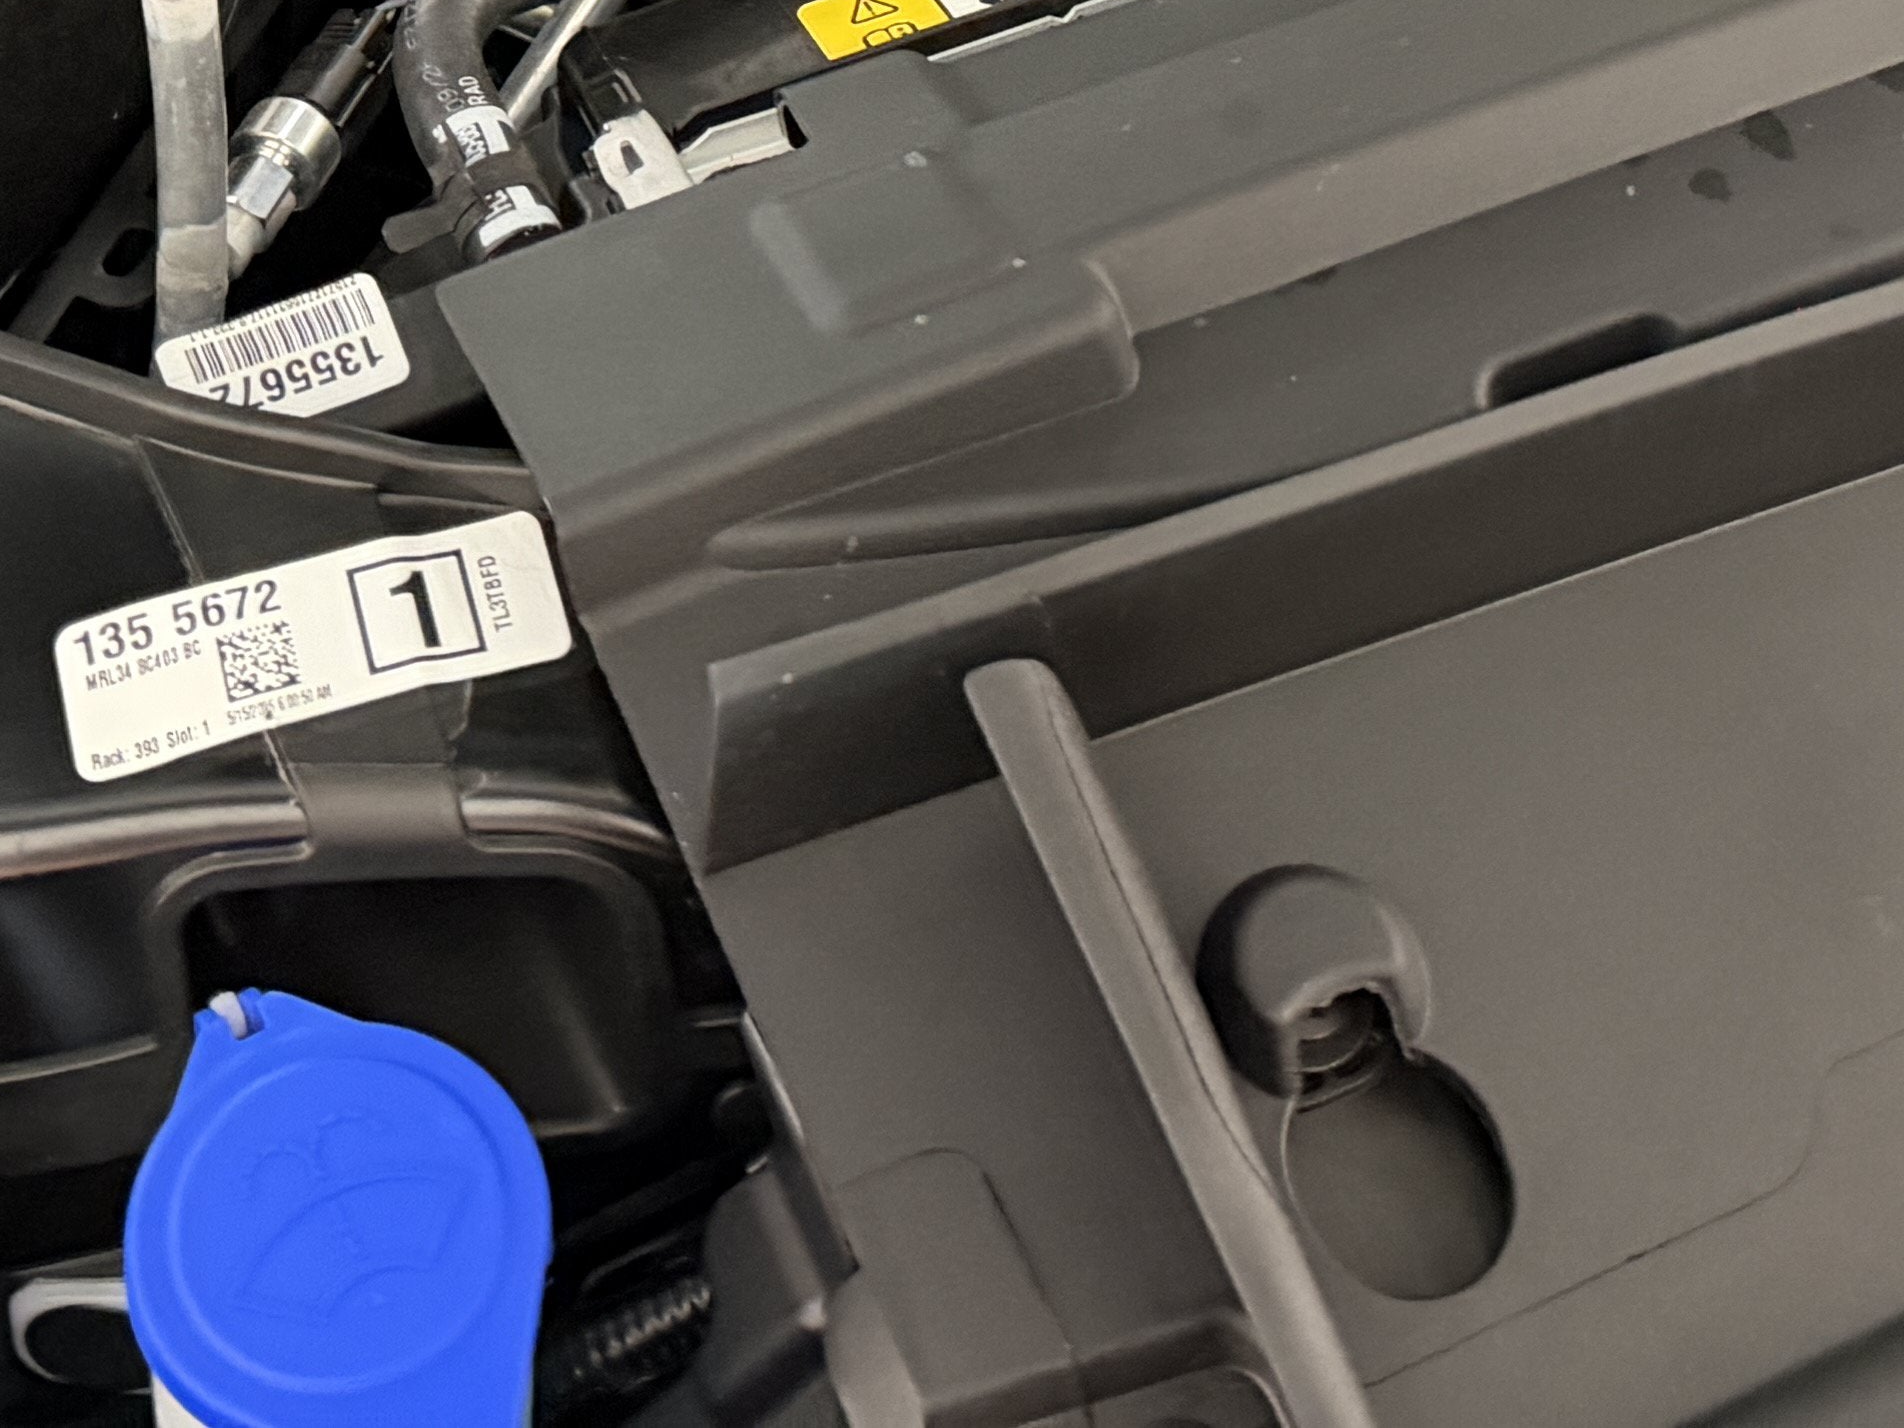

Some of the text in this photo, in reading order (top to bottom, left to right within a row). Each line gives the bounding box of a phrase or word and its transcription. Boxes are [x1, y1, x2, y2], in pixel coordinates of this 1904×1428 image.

[457, 74, 489, 106] RAD
[72, 579, 282, 666] 135 5672
[388, 569, 443, 649] 1
[85, 663, 133, 691] MRL34
[90, 719, 211, 772] Rack: 393 Slot: 1
